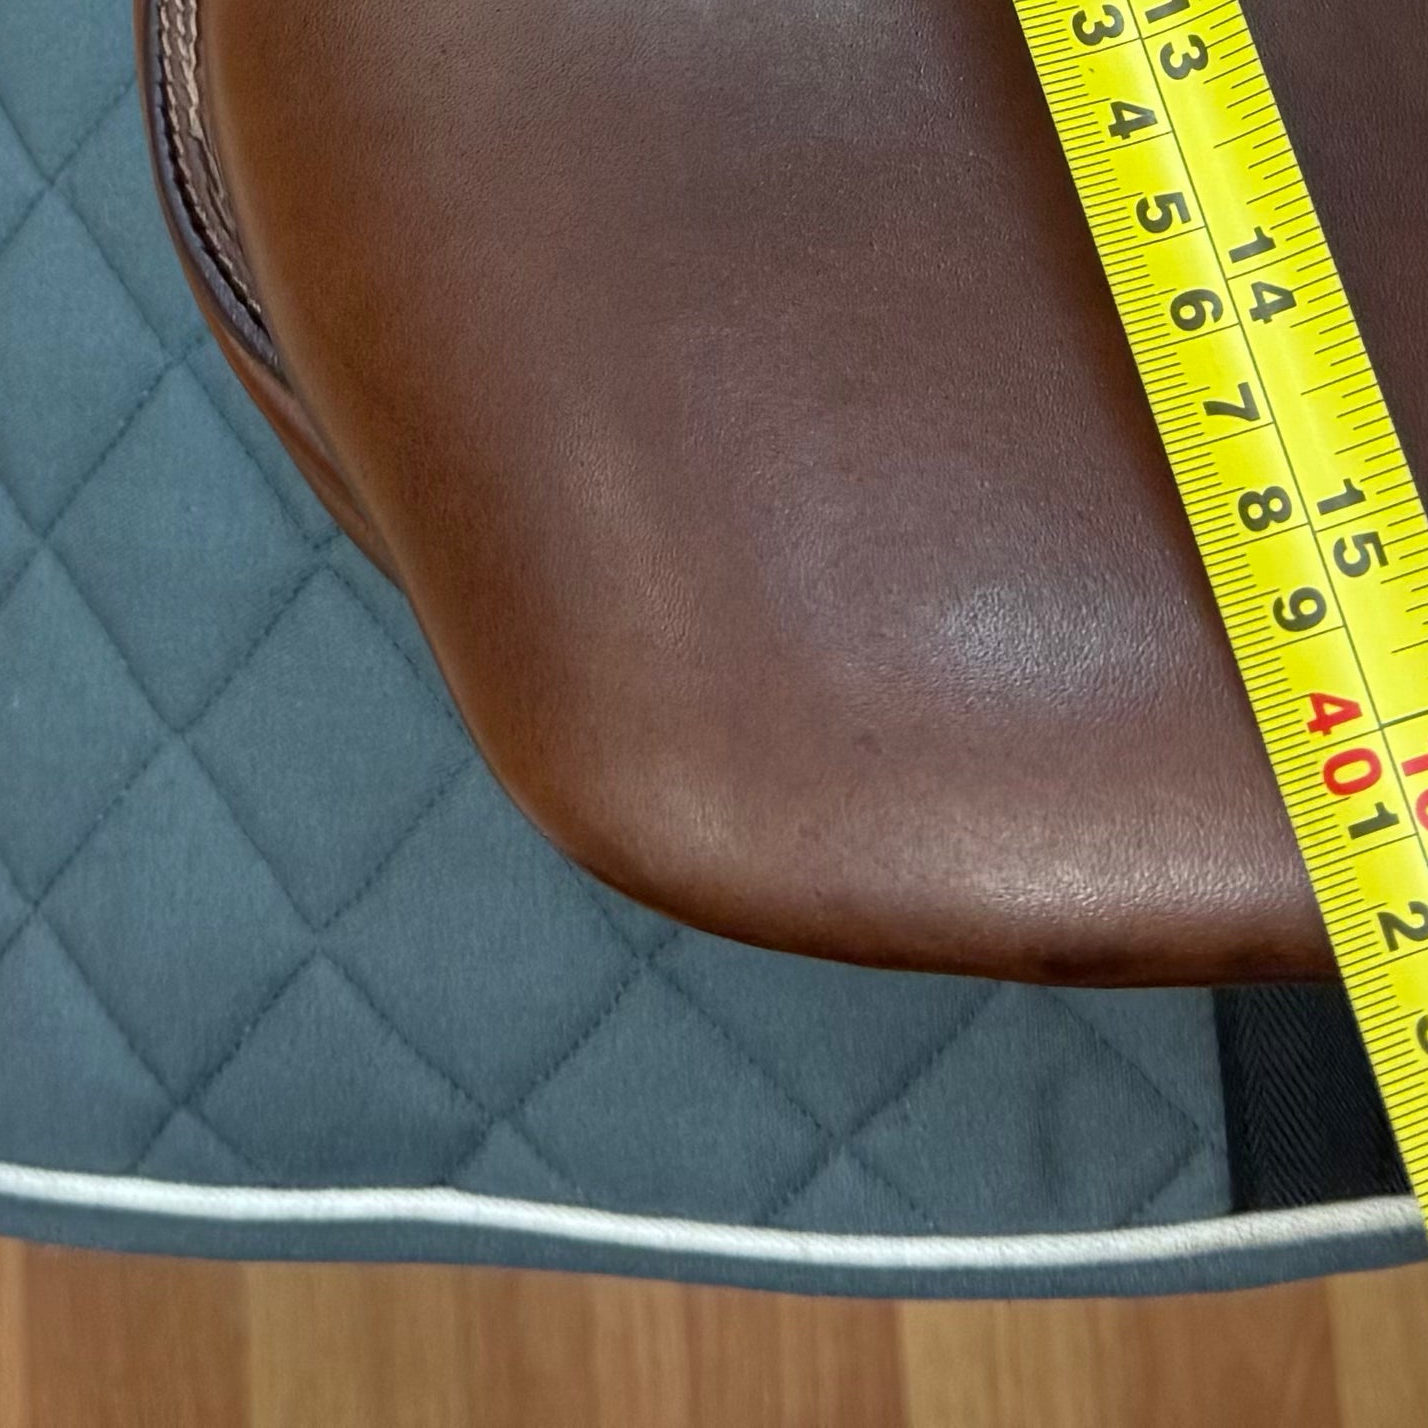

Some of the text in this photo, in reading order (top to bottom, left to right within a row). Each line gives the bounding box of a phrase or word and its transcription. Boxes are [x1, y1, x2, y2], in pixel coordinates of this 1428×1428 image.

[1072, 4, 1125, 46] 3
[1108, 100, 1158, 140] 4
[1136, 191, 1192, 234] 5
[1169, 288, 1224, 331] 6
[1203, 382, 1261, 421] 7
[1238, 485, 1292, 532] 8
[1273, 587, 1328, 632] 9
[1307, 692, 1383, 797] 40
[1347, 801, 1399, 839] 1
[1228, 226, 1297, 325] 14
[1317, 478, 1389, 578] 15
